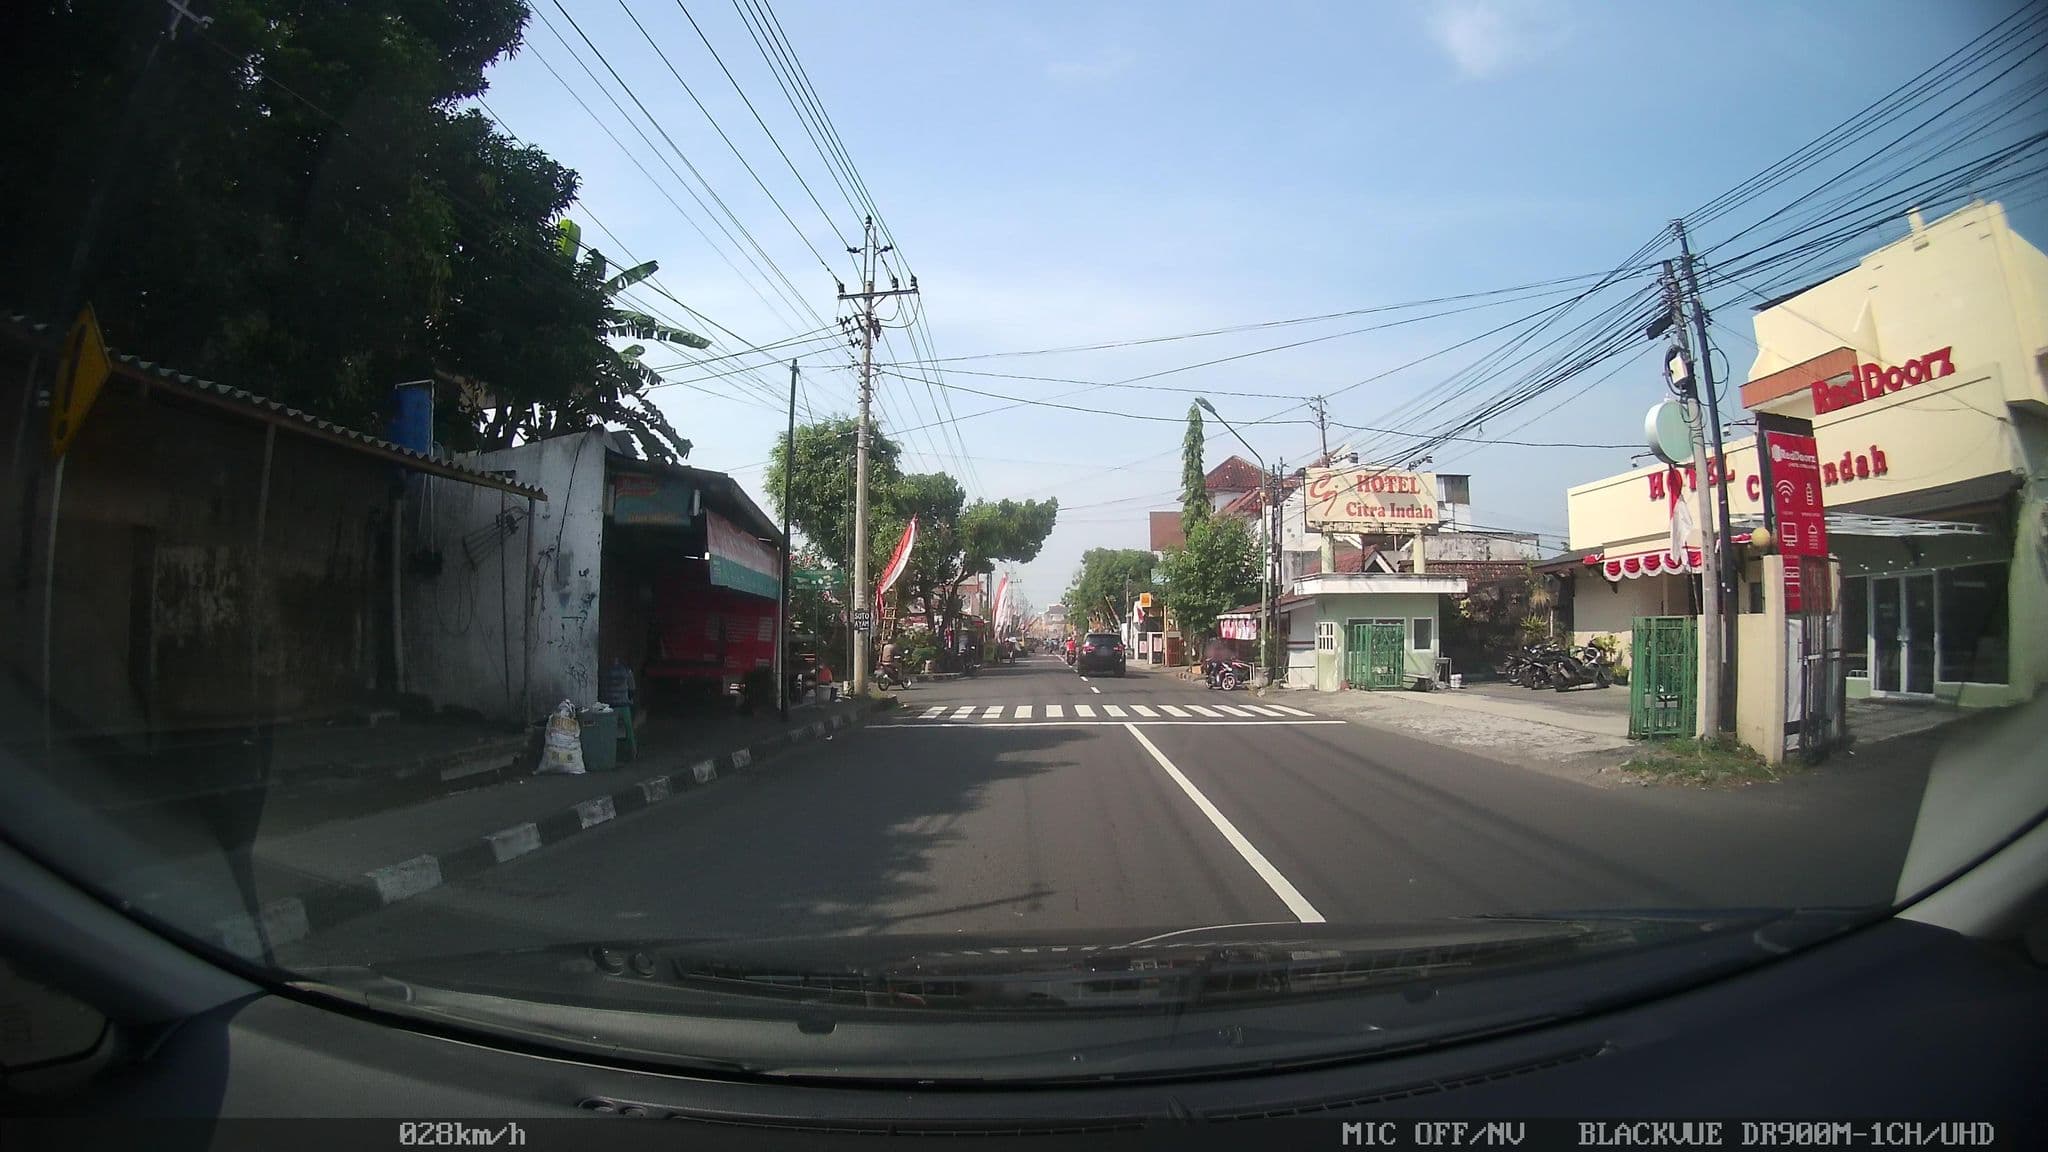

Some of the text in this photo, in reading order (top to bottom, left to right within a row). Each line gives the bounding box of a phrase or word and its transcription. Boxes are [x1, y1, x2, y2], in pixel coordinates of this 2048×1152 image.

[1811, 346, 1955, 415] RedDoorz
[1822, 445, 1888, 487] ndah
[1356, 475, 1421, 494] HOTEL
[1345, 501, 1434, 519] Citra Indah
[854, 612, 870, 620] SOTO
[854, 620, 870, 628] AYAM
